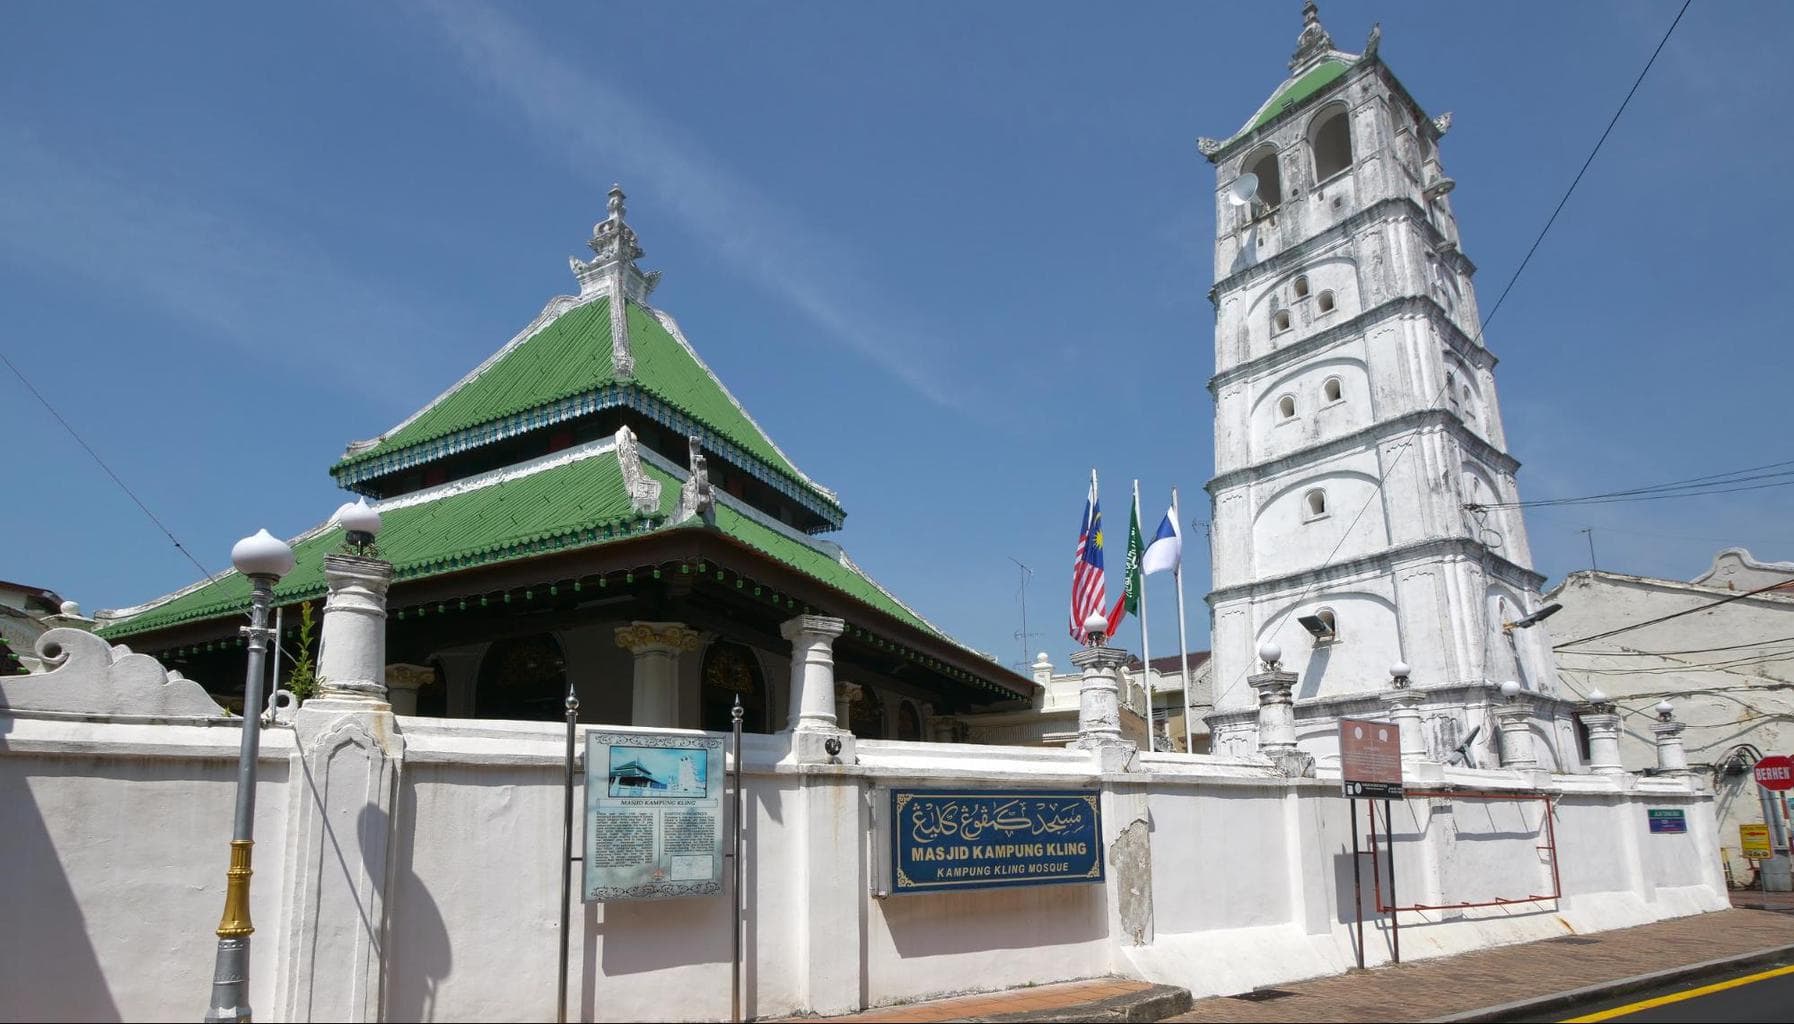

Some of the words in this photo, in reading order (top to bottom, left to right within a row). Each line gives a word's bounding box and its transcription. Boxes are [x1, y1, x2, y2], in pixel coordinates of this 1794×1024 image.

[1756, 767, 1790, 780] BERHEN
[911, 846, 969, 862] MASJID
[973, 843, 1043, 859] KAMPUNG
[1046, 842, 1087, 857] KLING
[936, 865, 991, 878] KAMPUNG
[994, 863, 1025, 875] KLING
[1028, 862, 1069, 873] MOSQUE
